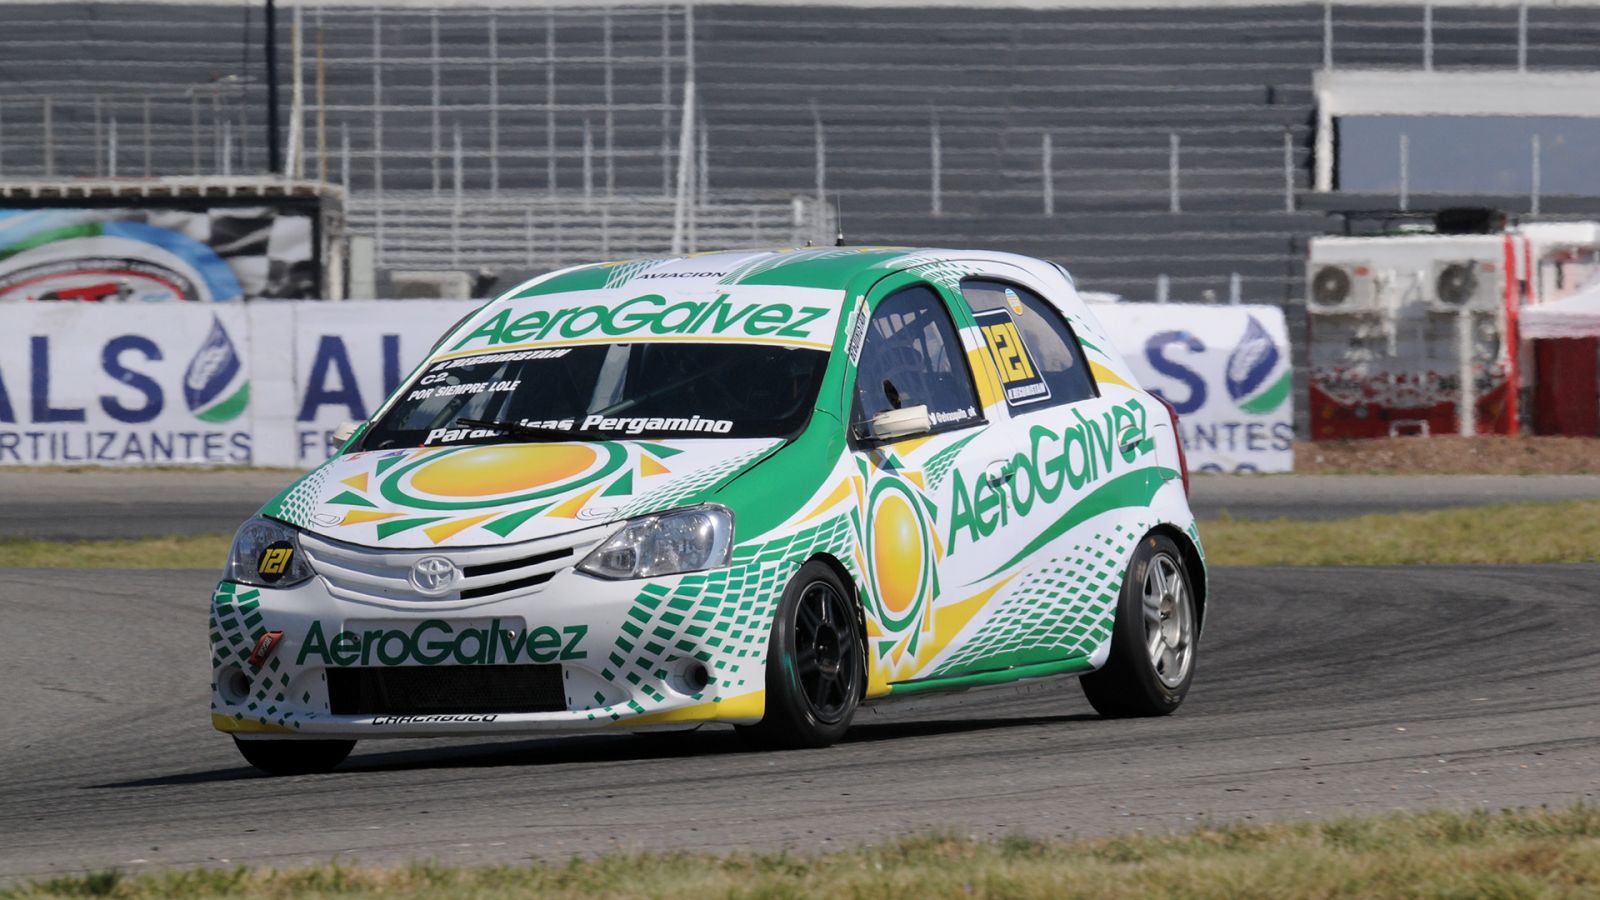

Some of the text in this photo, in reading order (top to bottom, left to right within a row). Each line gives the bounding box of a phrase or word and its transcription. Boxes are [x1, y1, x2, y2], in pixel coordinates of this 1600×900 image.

[635, 272, 727, 280] AVIACION
[450, 294, 830, 351] AeroGalvez
[980, 322, 1035, 383] 121
[0, 334, 164, 424] LS
[407, 380, 521, 402] POR SIEMPRE LOLE
[420, 372, 449, 386] C2
[580, 414, 734, 434] Pergamino
[947, 398, 1156, 557] AeroGalvez
[259, 548, 292, 574] 121
[296, 619, 588, 667] AeroGalvez
